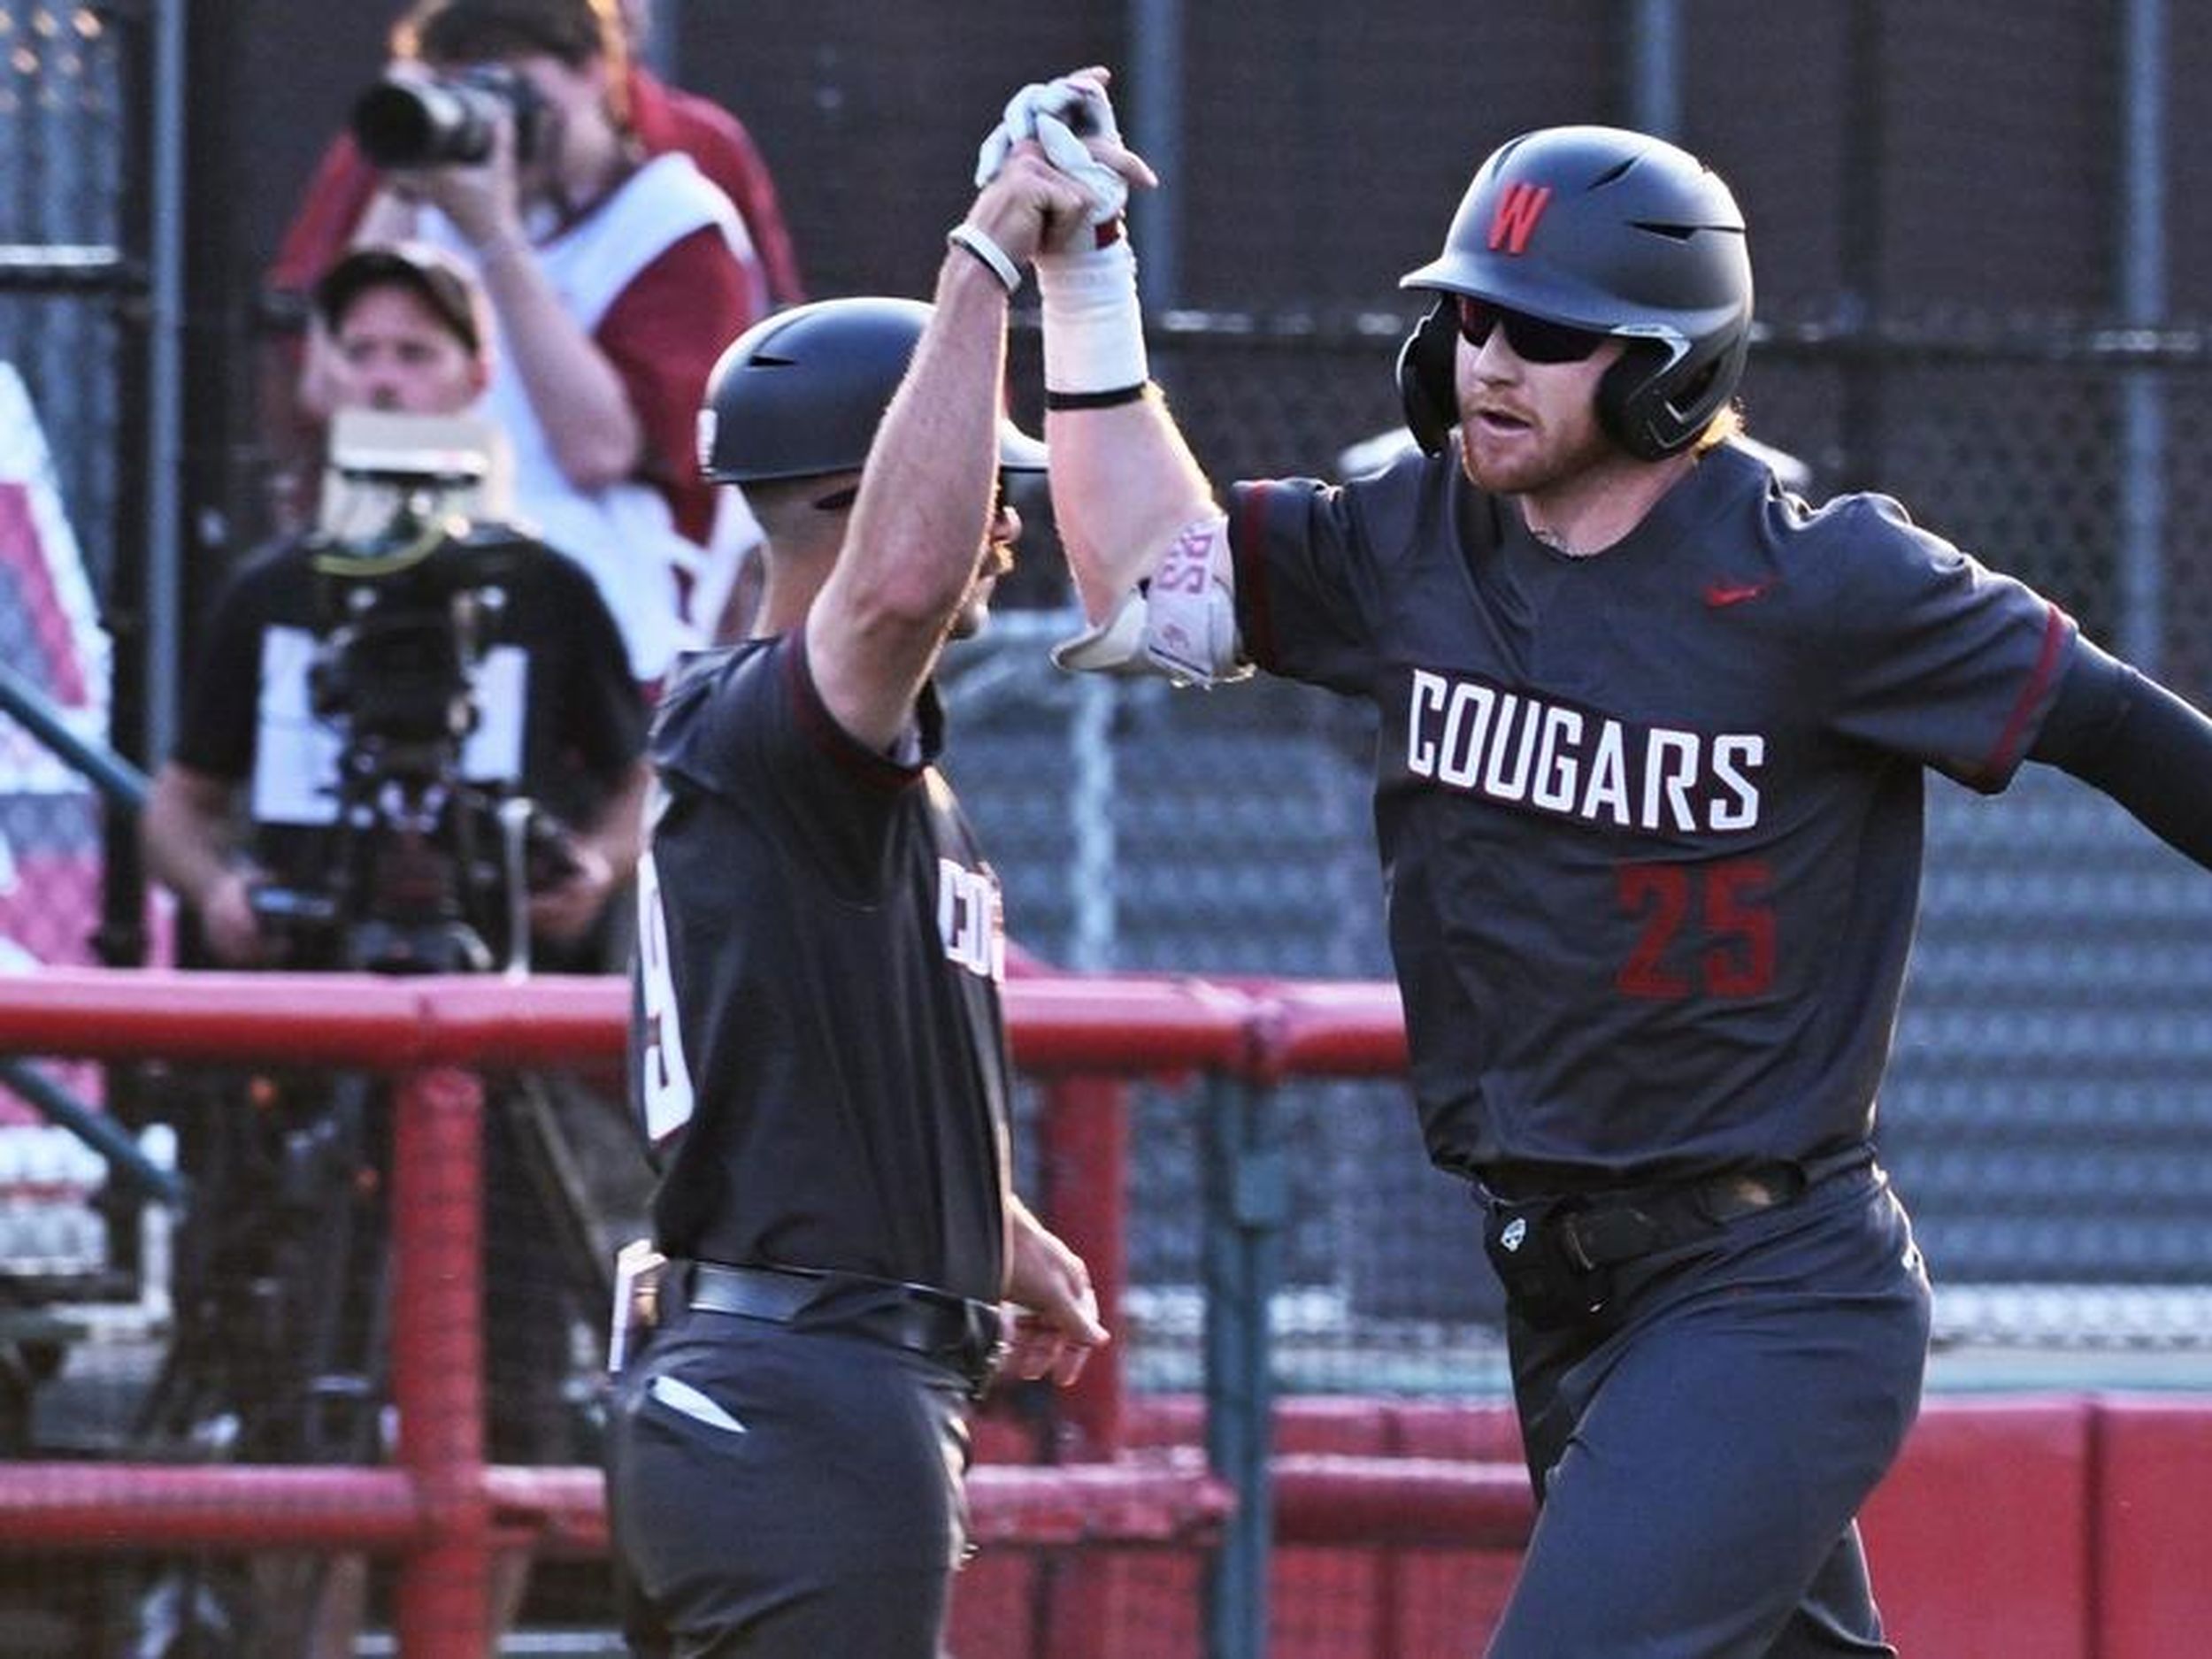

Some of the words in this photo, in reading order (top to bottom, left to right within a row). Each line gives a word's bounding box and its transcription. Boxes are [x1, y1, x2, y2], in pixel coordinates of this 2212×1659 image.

[1488, 182, 1551, 254] W
[1408, 669, 1765, 832] COUGARS
[1617, 859, 1777, 999] 25
